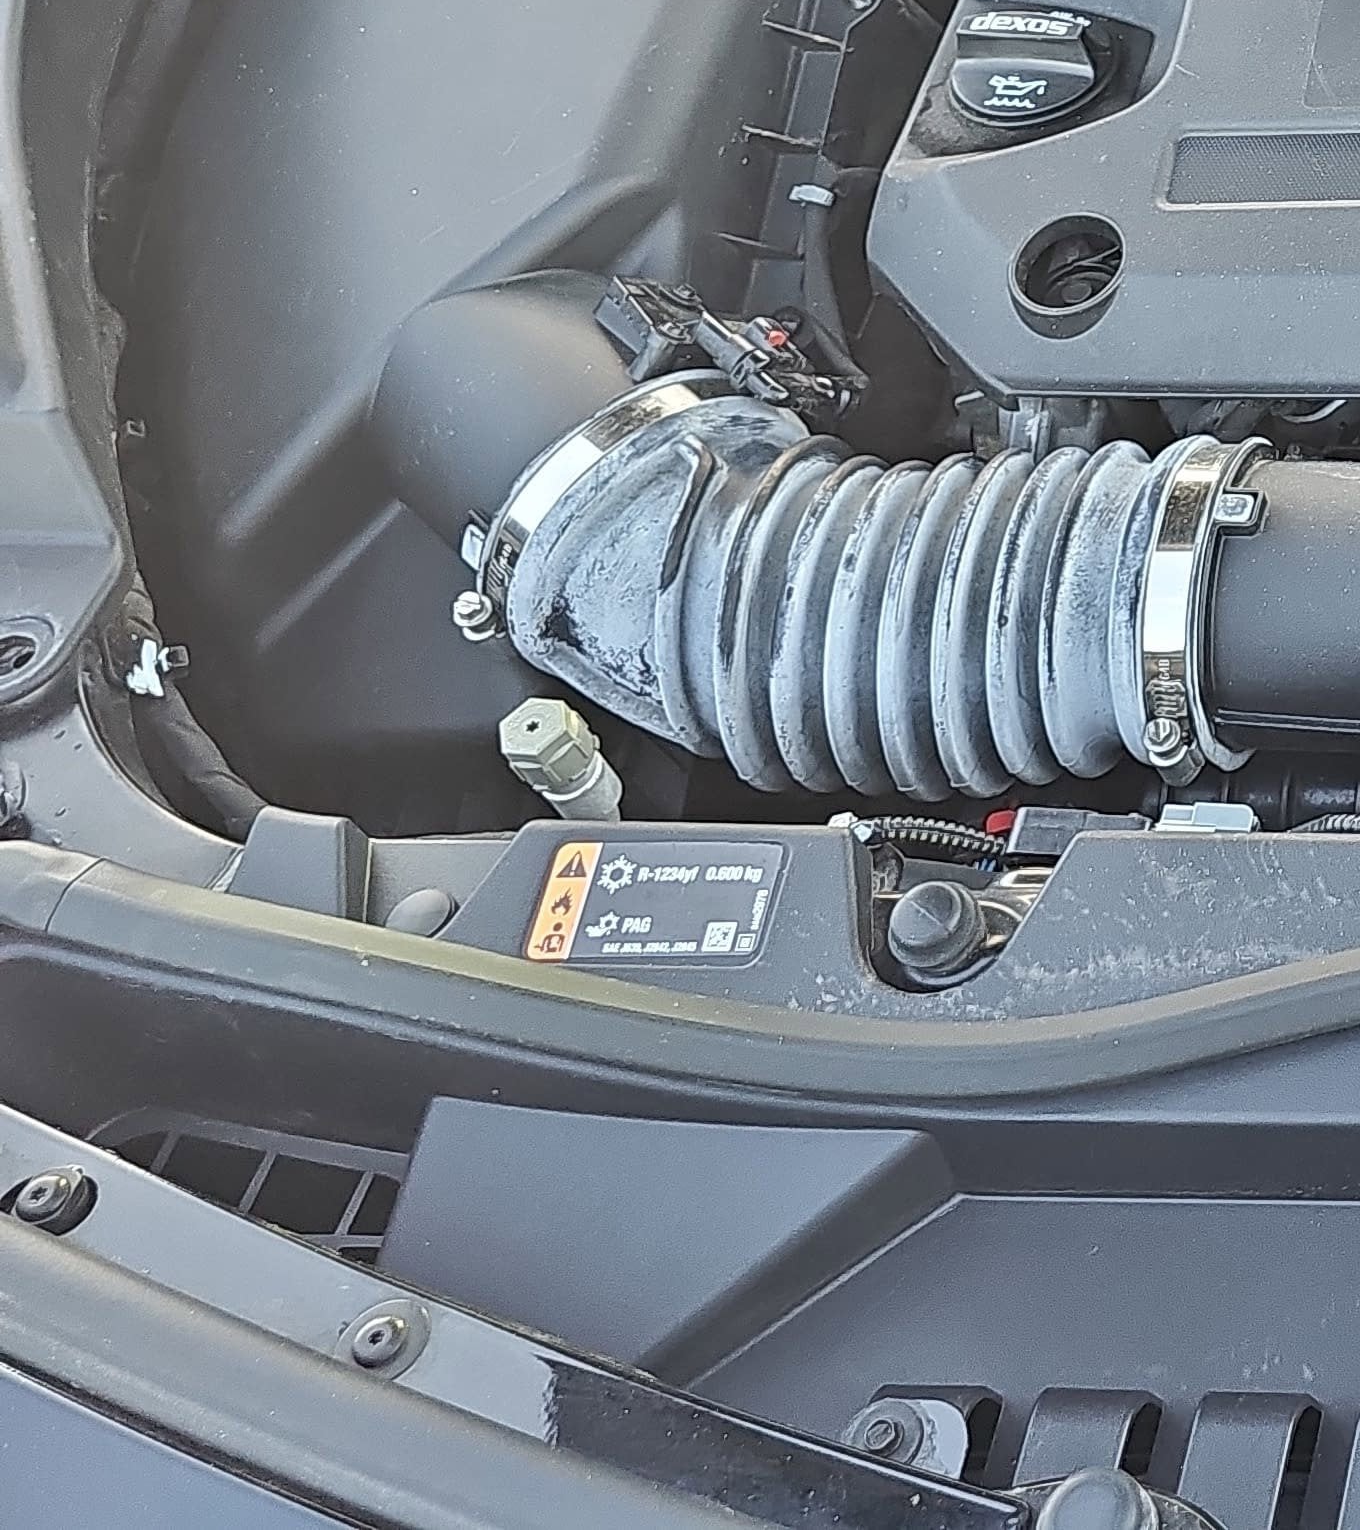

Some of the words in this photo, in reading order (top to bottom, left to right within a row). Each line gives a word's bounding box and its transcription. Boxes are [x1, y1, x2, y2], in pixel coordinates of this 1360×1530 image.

[969, 11, 1074, 36] dexos
[705, 866, 743, 882] 0.600
[621, 917, 652, 934] PAG
